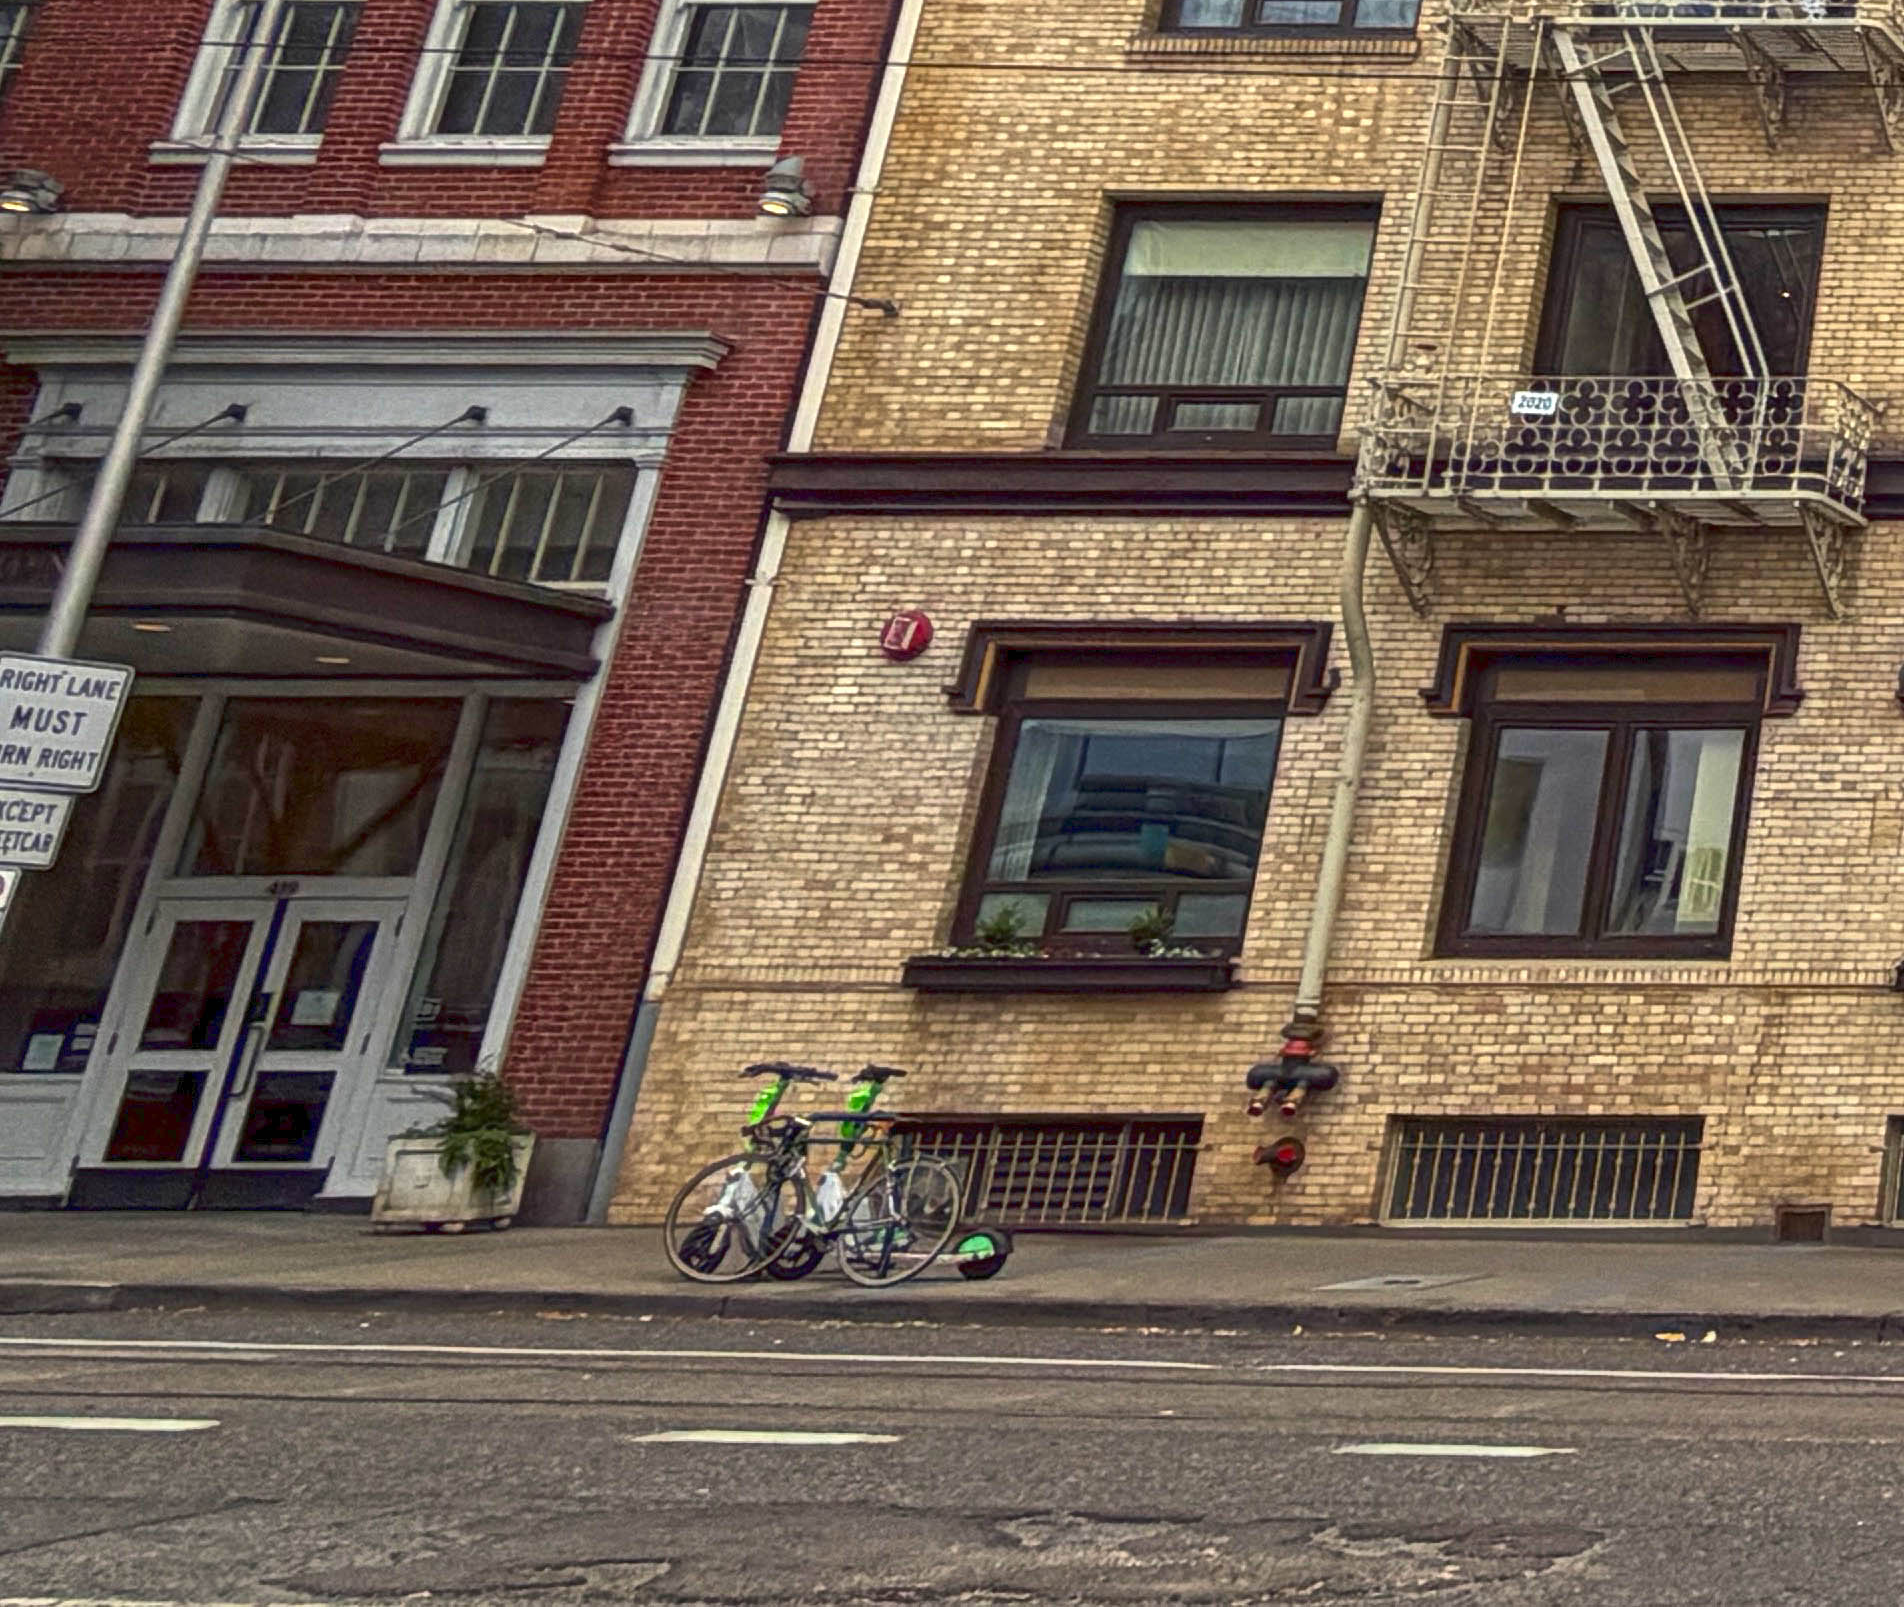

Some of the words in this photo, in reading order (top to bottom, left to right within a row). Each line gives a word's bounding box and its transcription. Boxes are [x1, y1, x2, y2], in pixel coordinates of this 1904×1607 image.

[0, 668, 63, 694] RIGHT
[66, 676, 121, 700] LANE
[9, 705, 88, 736] MUST
[0, 743, 32, 765] RN
[36, 747, 99, 772] RIGHT
